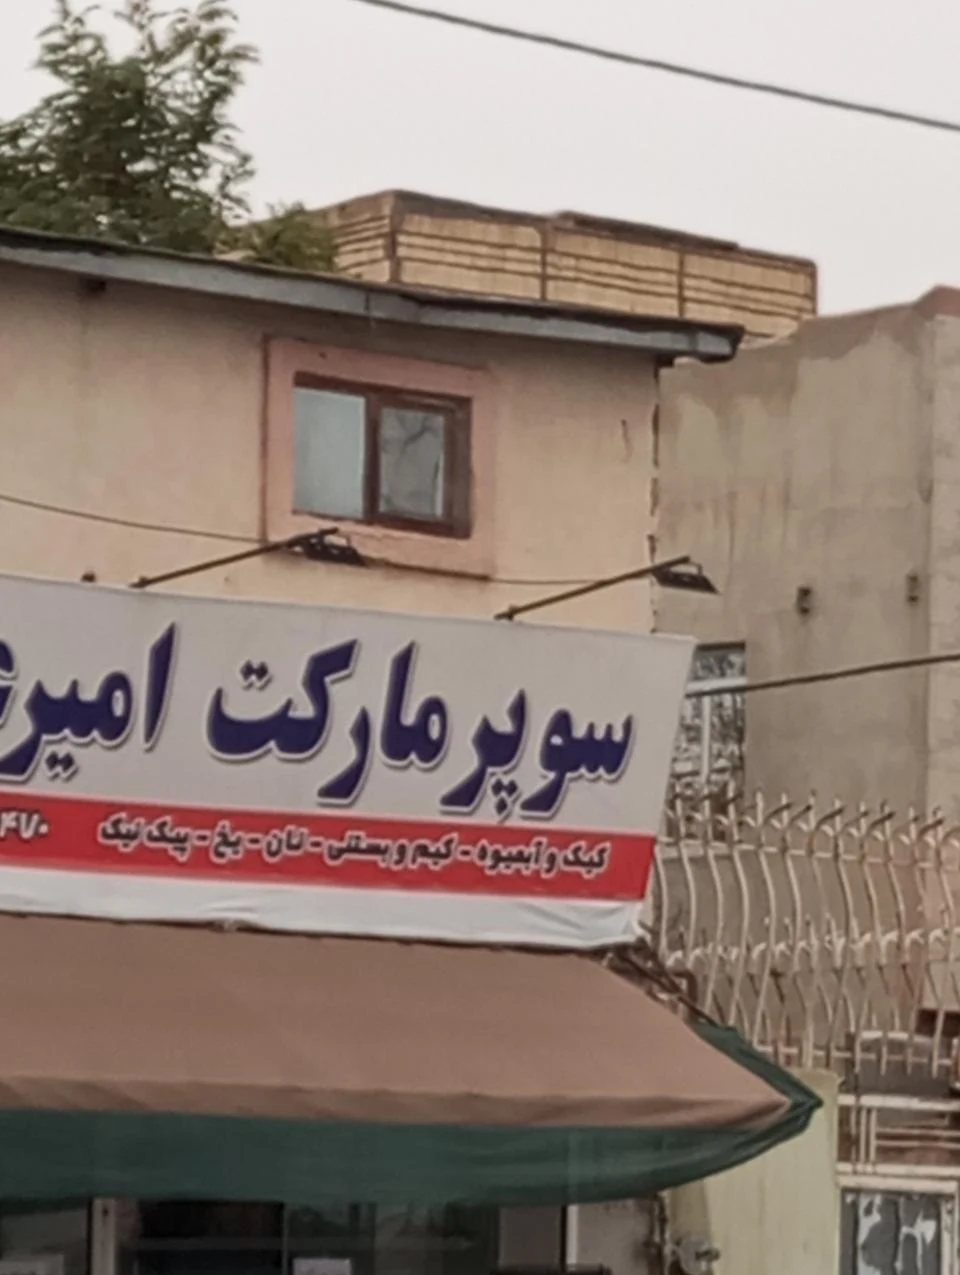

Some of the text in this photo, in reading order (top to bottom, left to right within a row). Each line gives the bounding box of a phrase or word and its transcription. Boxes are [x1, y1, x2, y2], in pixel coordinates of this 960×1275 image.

[209, 819, 244, 864] یخ
[261, 824, 309, 863] نان
[323, 829, 391, 870] بستنی
[560, 842, 611, 878] کیک
